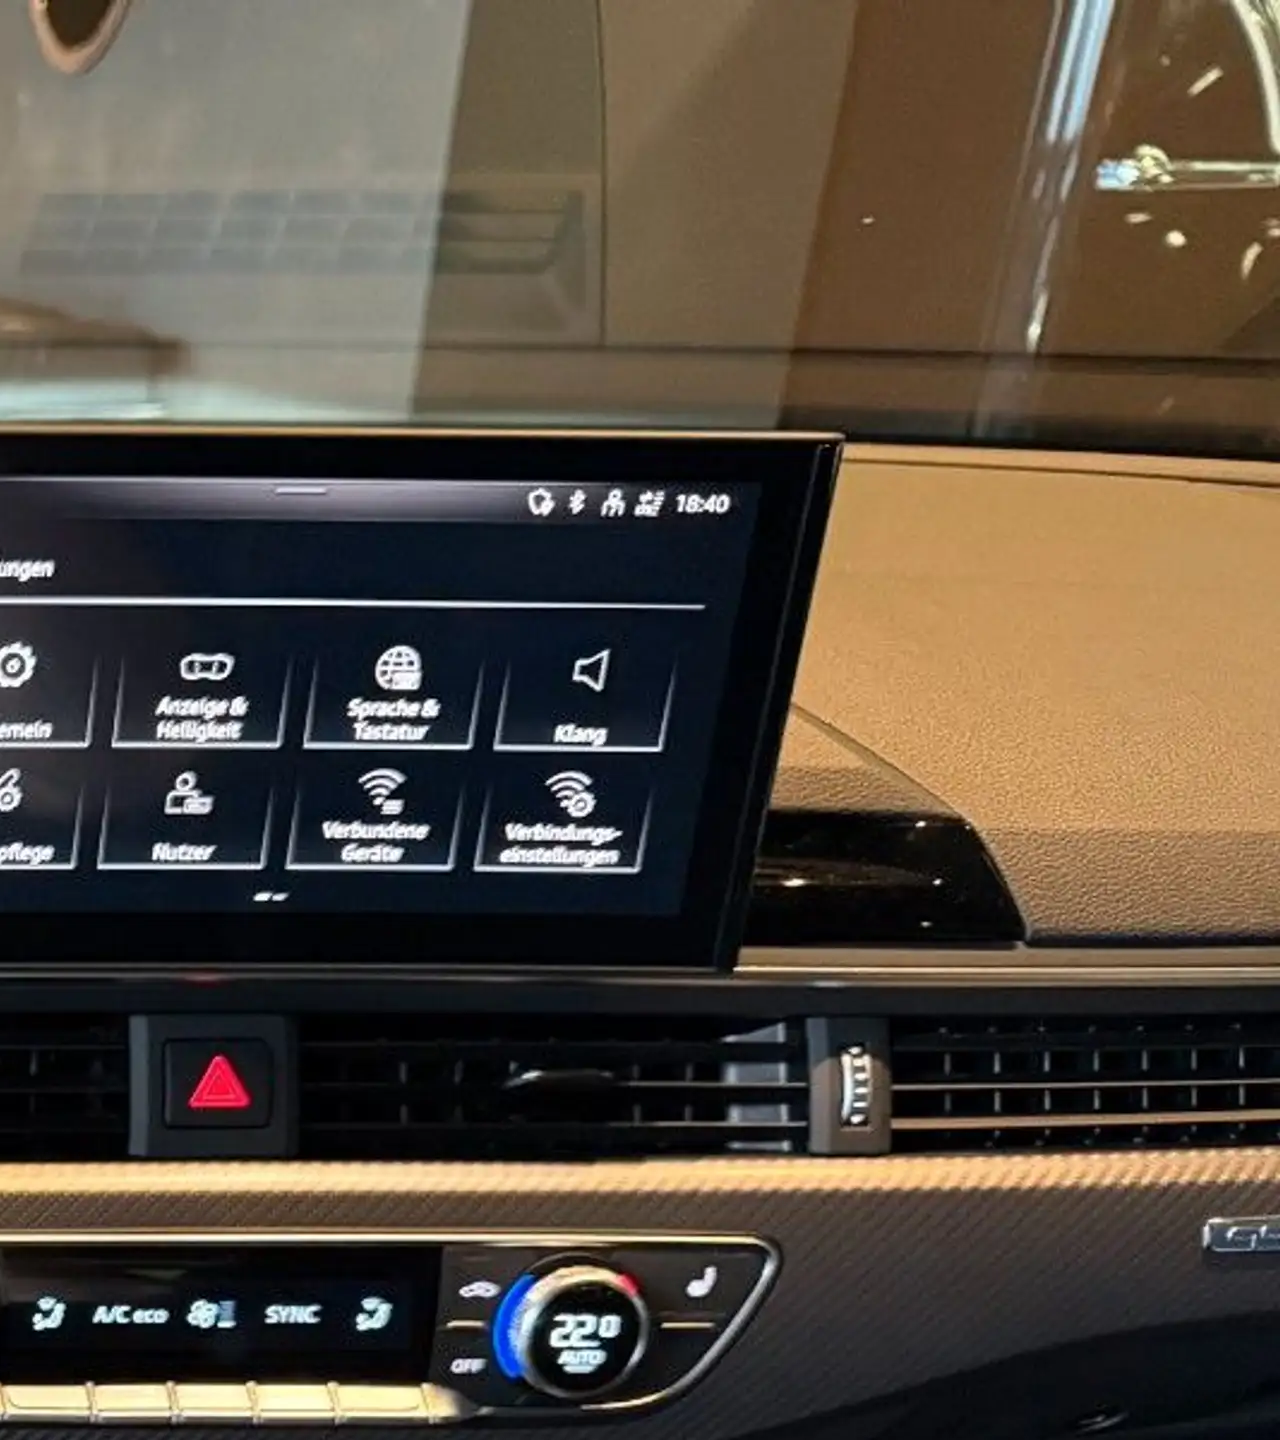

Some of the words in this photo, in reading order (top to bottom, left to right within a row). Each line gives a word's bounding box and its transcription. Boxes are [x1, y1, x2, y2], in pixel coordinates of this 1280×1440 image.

[675, 493, 731, 513] 18:40
[156, 696, 226, 722] Anzeige
[228, 697, 247, 717] &
[347, 697, 418, 722] Sprache
[420, 698, 439, 718] &
[155, 718, 241, 744] Helligkeit
[353, 720, 428, 742] Tastatur
[553, 722, 607, 747] Klang
[322, 820, 428, 843] Verbundene
[504, 822, 622, 847] Verbindungs-
[151, 840, 214, 863] Nutzer
[341, 842, 403, 865] Geräte
[499, 845, 620, 869] einstellungen
[93, 1305, 130, 1325] A/C
[133, 1307, 169, 1325] eco
[264, 1304, 321, 1325] SYNC
[450, 1357, 487, 1375] OFF
[557, 1349, 607, 1365] AUTO
